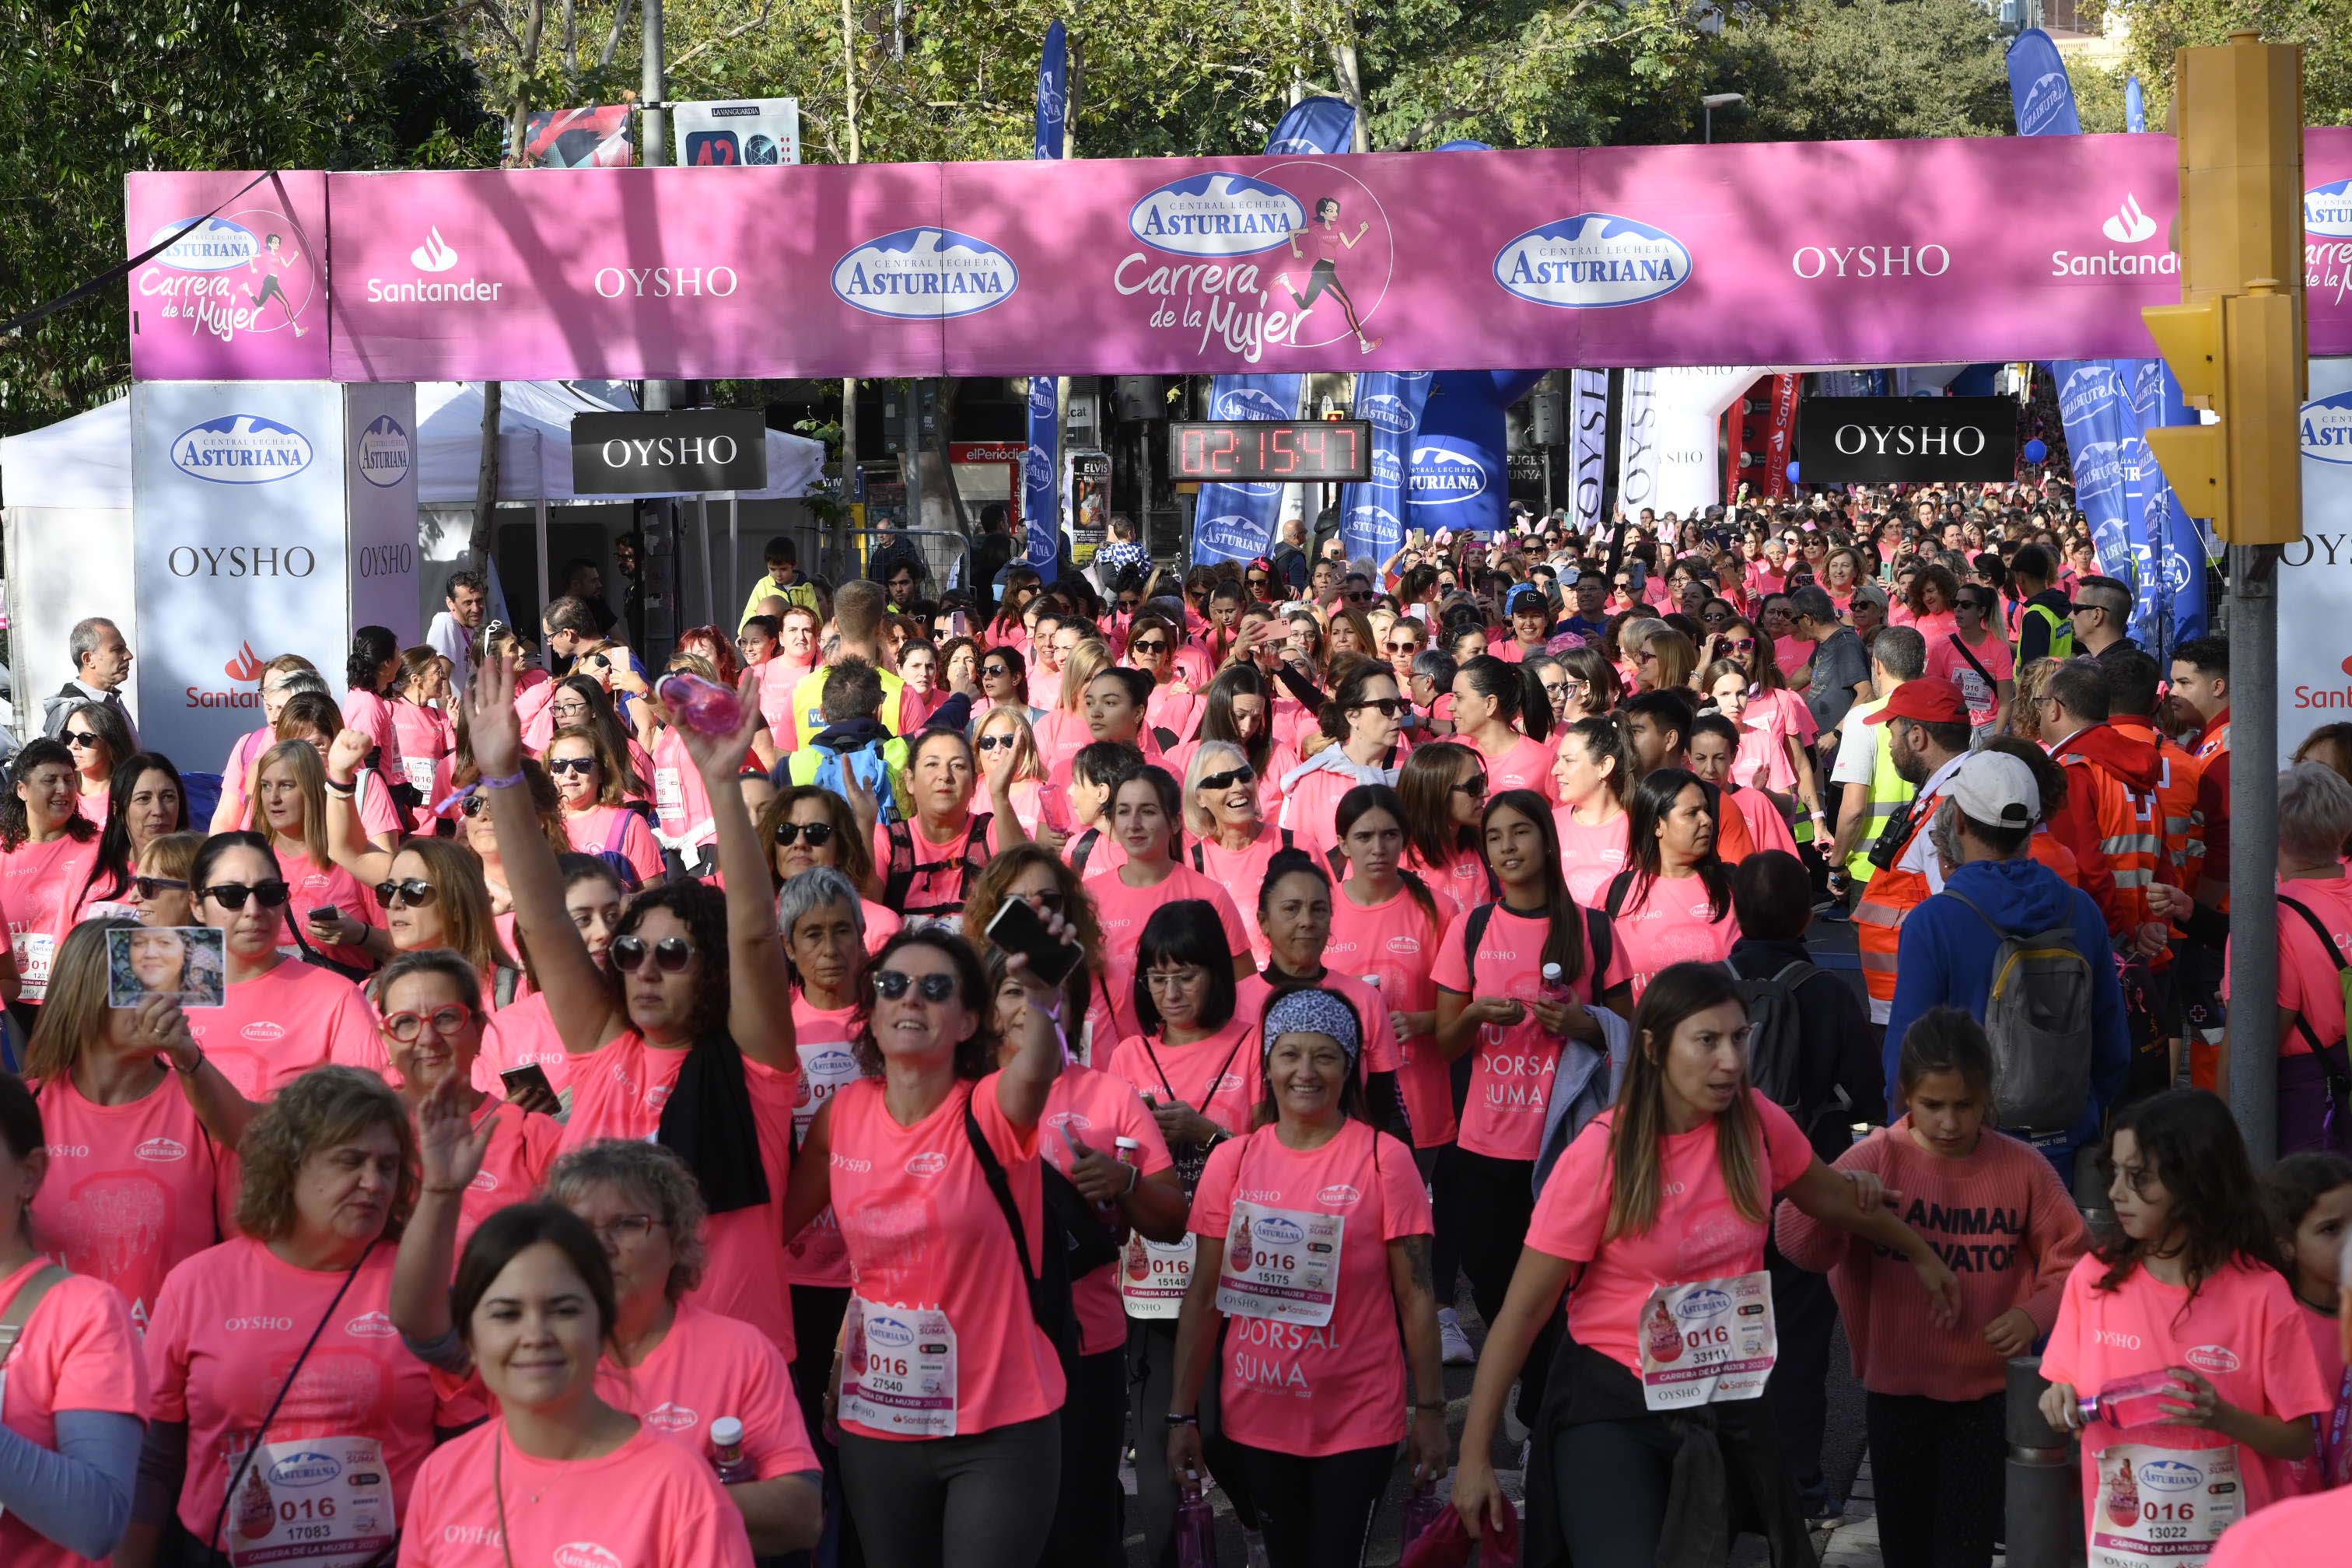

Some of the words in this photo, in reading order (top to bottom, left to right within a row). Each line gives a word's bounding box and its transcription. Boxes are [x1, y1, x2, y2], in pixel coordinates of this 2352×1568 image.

[720, 107, 759, 116] VANGUARDIA
[1169, 201, 1226, 211] CENTRAL
[1230, 200, 1287, 210] LECHERA
[1142, 202, 1292, 236] ASTURIANA
[1539, 245, 1601, 257] CENTRAL
[1606, 244, 1671, 256] LECHERA
[2305, 243, 2352, 266] arre
[874, 257, 933, 268] CENTRAL
[939, 257, 999, 268] LECHERA
[1507, 250, 1677, 285] ASTURIANA
[1792, 243, 1950, 279] OYSHO
[2051, 250, 2181, 277] Santand
[138, 267, 230, 297] Carrera
[594, 266, 738, 299] OYSHO
[846, 261, 1004, 296] ASTURIANA
[1114, 252, 1260, 296] Carrera
[2324, 265, 2338, 287] la
[367, 277, 502, 303] Santander
[161, 298, 178, 318] de
[182, 298, 194, 318] la
[192, 292, 265, 342] Mujer
[1150, 297, 1178, 328] de
[1182, 297, 1202, 328] la
[1198, 290, 1314, 364] Mujer
[1577, 369, 1608, 520] OYSH
[1625, 369, 1657, 506] OYSH
[1835, 424, 1986, 457] OYSHO
[181, 439, 303, 467] ASTURIANA
[362, 446, 408, 470] ASTURIANA
[602, 435, 738, 468] OYSHO
[1181, 429, 1356, 473] 02:15:47
[1083, 463, 1108, 473] ELVIS
[1374, 467, 1401, 481] URIAN
[1770, 455, 1782, 498] ports
[1409, 475, 1479, 490] TURIANA
[1203, 527, 1267, 555] ASTURIANA
[2278, 534, 2352, 567] OY
[168, 546, 316, 578] OYSHO
[359, 543, 411, 578] OYSHO
[1479, 950, 1517, 961] OYSHO
[31, 960, 49, 970] 01
[812, 1060, 852, 1071] ASTURIANA
[1482, 1052, 1556, 1076] DORSA
[814, 1082, 851, 1098] 01
[45, 1145, 89, 1159] YSHO
[137, 1146, 186, 1157] ASTURIANA
[1905, 1197, 2020, 1236] ANIMAL
[1256, 1224, 1300, 1241] ASTURIANA
[1152, 1259, 1190, 1274] 016
[1255, 1251, 1296, 1270] 016
[1157, 1278, 1187, 1286] 15148
[1257, 1272, 1290, 1285] 15175
[1131, 1289, 1160, 1297] CARRERA
[1281, 1289, 1305, 1299] MUJER
[1735, 1286, 1761, 1297] SUMA
[1129, 1301, 1161, 1312] OYSHO
[1223, 1293, 1259, 1308] OYSHO
[1681, 1300, 1727, 1316] ASTURIANA
[225, 1316, 292, 1332] OYSHO
[1237, 1316, 1340, 1350] DORSAL
[1686, 1325, 1729, 1348] 016
[870, 1354, 908, 1376] 016
[1692, 1349, 1728, 1364] 33111
[1235, 1351, 1308, 1388] SUMA
[1659, 1369, 1698, 1382] CARRERA
[1698, 1367, 1710, 1376] DE
[1710, 1366, 1721, 1375] LA
[873, 1377, 903, 1392] 27540
[1729, 1380, 1764, 1391] Santan
[895, 1398, 922, 1407] MUJER
[1658, 1387, 1701, 1402] OYSHO
[903, 1416, 947, 1426] Santander
[273, 1467, 336, 1481] ASTURIANA
[2144, 1469, 2200, 1485] ASTURIANA
[279, 1496, 337, 1521] 016
[2144, 1501, 2196, 1521] 016
[287, 1524, 331, 1541] 17083
[2147, 1526, 2188, 1539] 13022
[2109, 1538, 2149, 1552] CARRERA
[2150, 1543, 2163, 1552] DE
[2164, 1543, 2177, 1552] LA
[2178, 1543, 2209, 1552] MUJER
